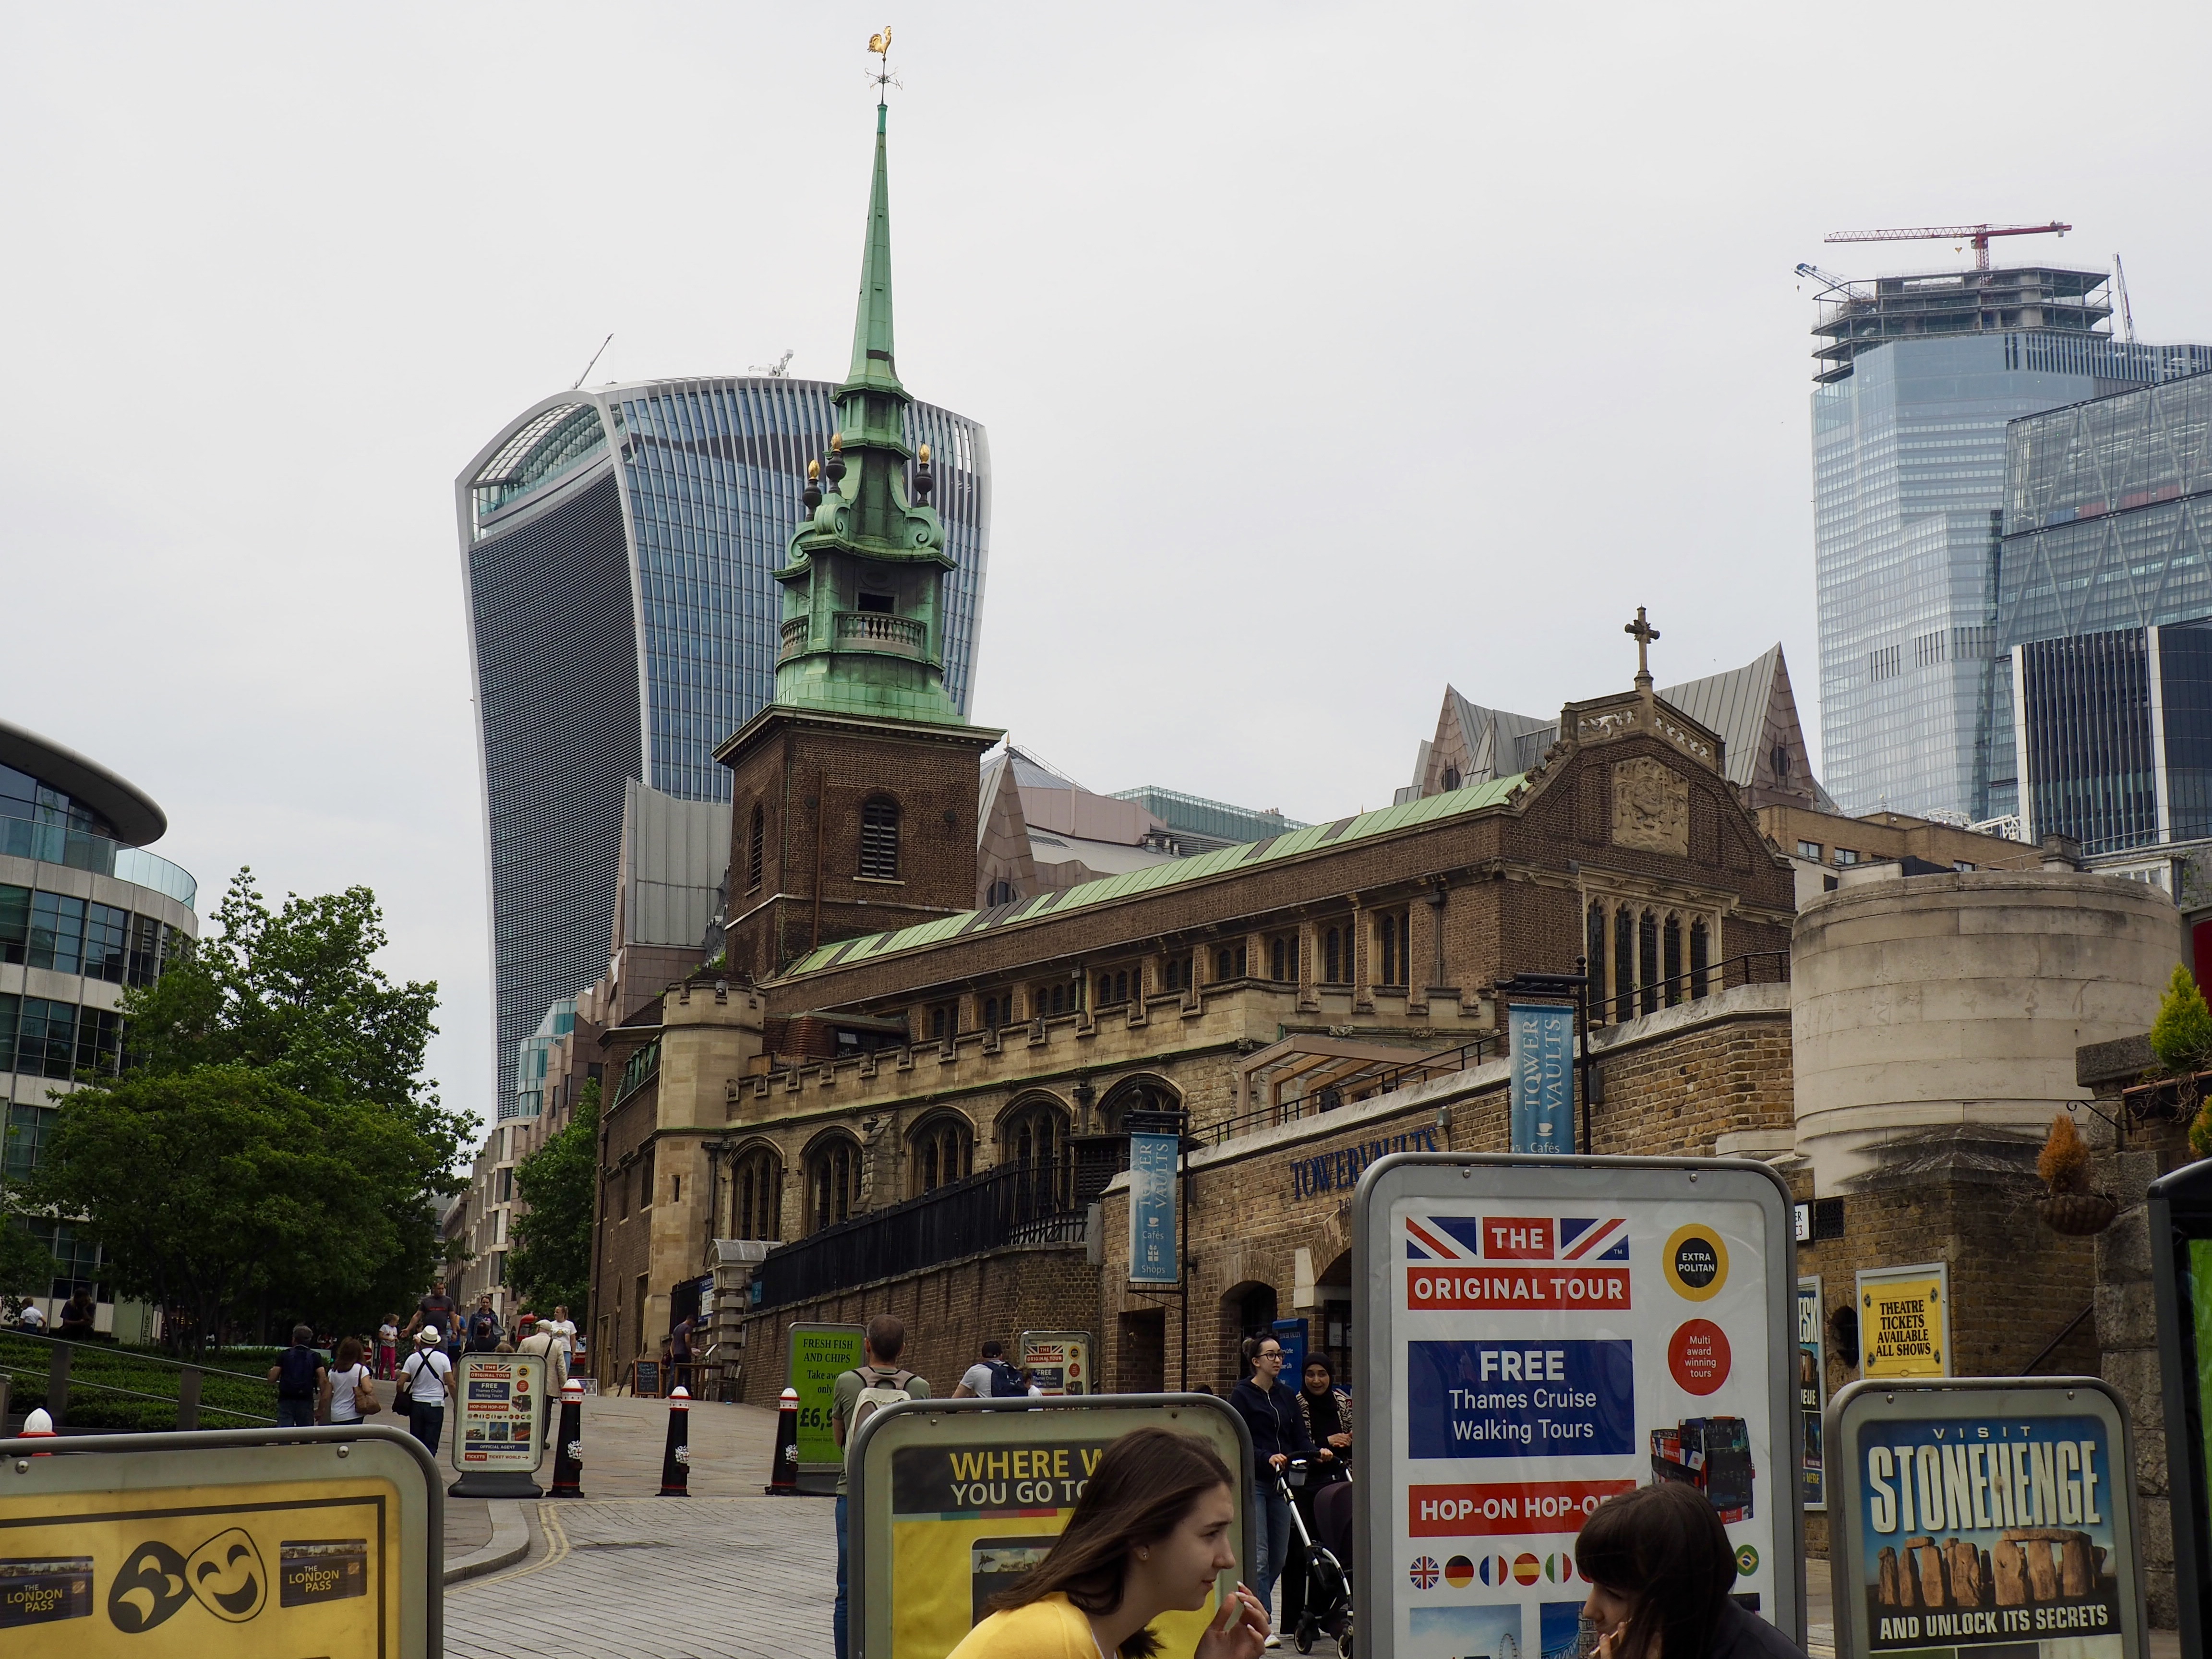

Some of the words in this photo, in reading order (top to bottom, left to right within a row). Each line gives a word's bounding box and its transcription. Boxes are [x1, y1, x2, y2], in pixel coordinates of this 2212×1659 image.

[1523, 1019, 1541, 1111] TOWER
[1545, 1019, 1563, 1111] VAULTS
[1530, 1142, 1560, 1154] Cafés
[1139, 1143, 1152, 1209] TOWER
[1155, 1143, 1168, 1209] VAULTS
[1290, 1147, 1359, 1200] TOWER
[1142, 1231, 1164, 1239] Cafés
[1491, 1228, 1543, 1249] THE
[1682, 1252, 1711, 1261] EXTRA
[1142, 1265, 1165, 1275] Shops
[1678, 1263, 1715, 1272] POLITAN
[1414, 1277, 1545, 1299] ORIGINAL
[1550, 1278, 1623, 1299] TOUR
[1880, 1299, 1924, 1315] THEATRE
[1880, 1314, 1924, 1330] TICKETS
[1690, 1335, 1710, 1345] Multi
[1877, 1329, 1928, 1343] AVAILABLE
[803, 1338, 831, 1348] FRESH
[834, 1340, 853, 1349] FISH
[1876, 1345, 1894, 1357] ALL
[1897, 1343, 1931, 1356] SHOWS
[804, 1353, 822, 1362] AND
[825, 1354, 850, 1363] CHIPS
[1687, 1346, 1711, 1356] award
[1480, 1350, 1564, 1381] FREE
[1684, 1358, 1716, 1368] winning
[807, 1370, 825, 1380] Take
[1690, 1369, 1712, 1378] tours
[817, 1384, 833, 1396] only
[1449, 1388, 1527, 1409] Thames
[1534, 1387, 1597, 1408] Cruise
[1453, 1419, 1531, 1444] Walking
[1538, 1419, 1593, 1439] Tours
[1933, 1426, 2031, 1439] VISIT
[950, 1450, 1069, 1481] WHERE
[950, 1482, 1007, 1505] YOU
[1016, 1481, 1053, 1503] GO
[1868, 1441, 2100, 1533] STONEHENGE
[1421, 1498, 1517, 1521] HOP-ON
[1525, 1495, 1617, 1518] HOP-O
[289, 1570, 339, 1584] LONDON
[305, 1580, 331, 1592] PASS
[7, 1589, 62, 1604] LONDON
[25, 1600, 54, 1612] PASS
[1880, 1616, 1919, 1640] AND
[1926, 1611, 1998, 1637] UNLOCK
[2003, 1610, 2030, 1632] ITS
[2036, 1604, 2108, 1630] SECRETS
